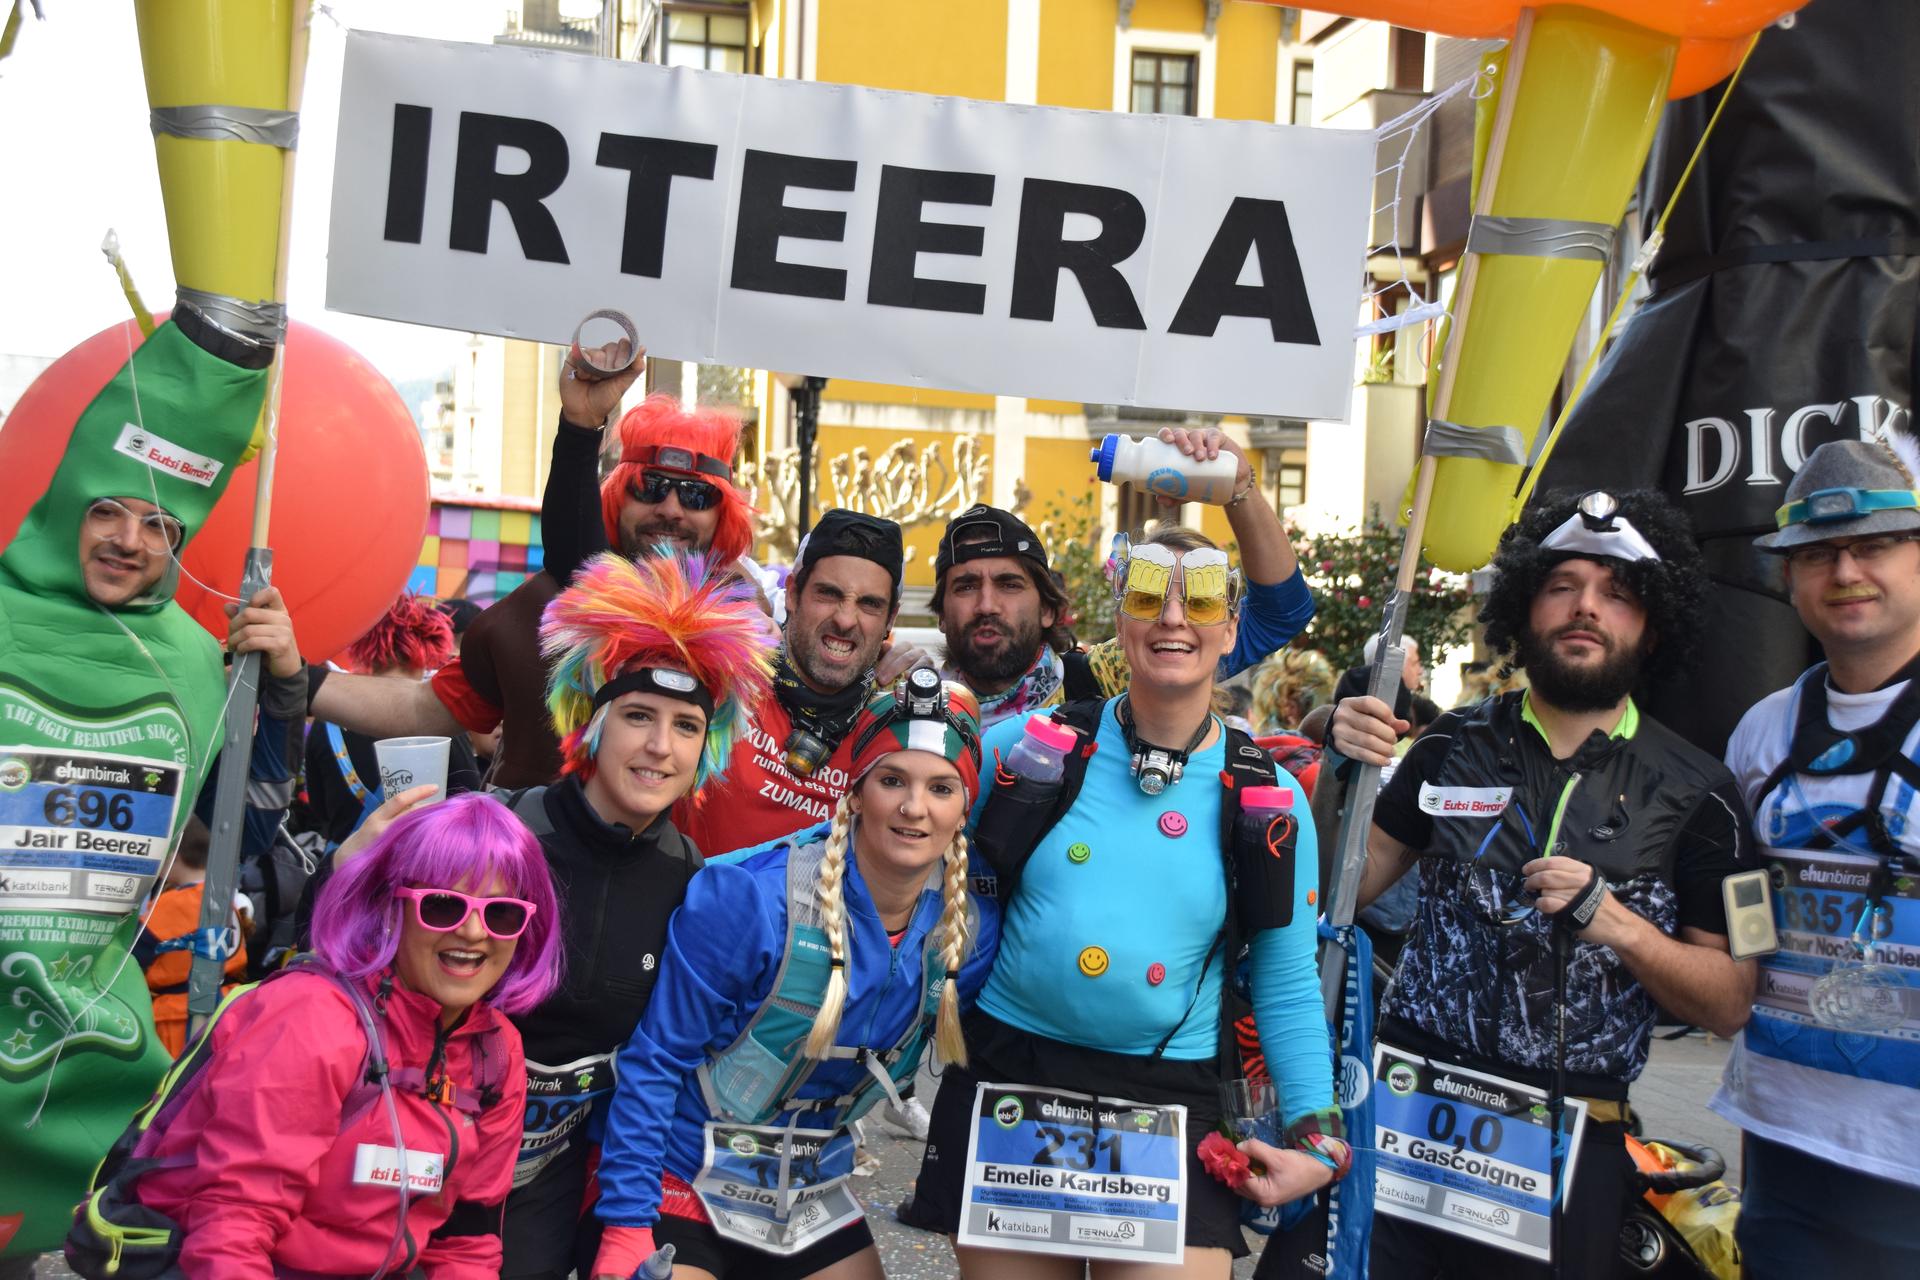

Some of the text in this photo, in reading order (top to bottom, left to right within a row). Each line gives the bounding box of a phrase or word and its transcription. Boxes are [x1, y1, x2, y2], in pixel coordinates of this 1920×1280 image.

[384, 103, 1322, 346] IRTEERA
[148, 447, 181, 470] Eutsi
[180, 462, 215, 481] Birrari!
[5, 703, 34, 726] THE
[36, 716, 72, 743] UGLY
[72, 725, 145, 748] BEAUTIFUL
[146, 723, 181, 747] SINCE
[55, 760, 131, 784] ehunbirrak
[805, 781, 826, 794] eta
[44, 787, 135, 831] 696
[759, 779, 830, 820] ZUMAIA
[1443, 800, 1470, 811] Eutsi
[15, 829, 152, 857] Jair Beerezi
[0, 914, 54, 930] REMIUM
[57, 916, 89, 931] EXTRA
[29, 929, 67, 943] ULTRA
[69, 932, 98, 946] QUALITY
[1433, 1074, 1508, 1109] ehunbirrak
[1042, 1099, 1117, 1124] ehunbiak
[1427, 1103, 1503, 1155] 0,0
[1032, 1127, 1122, 1173] 231
[1381, 1131, 1399, 1153] P.
[1408, 1138, 1537, 1193] Gascoigne
[391, 1168, 443, 1188] Brrari!
[983, 1165, 1054, 1188] Emelie
[1060, 1171, 1171, 1203] Karlsberg
[1451, 1203, 1493, 1223] TERNUA
[1077, 1227, 1120, 1239] TERNUA
